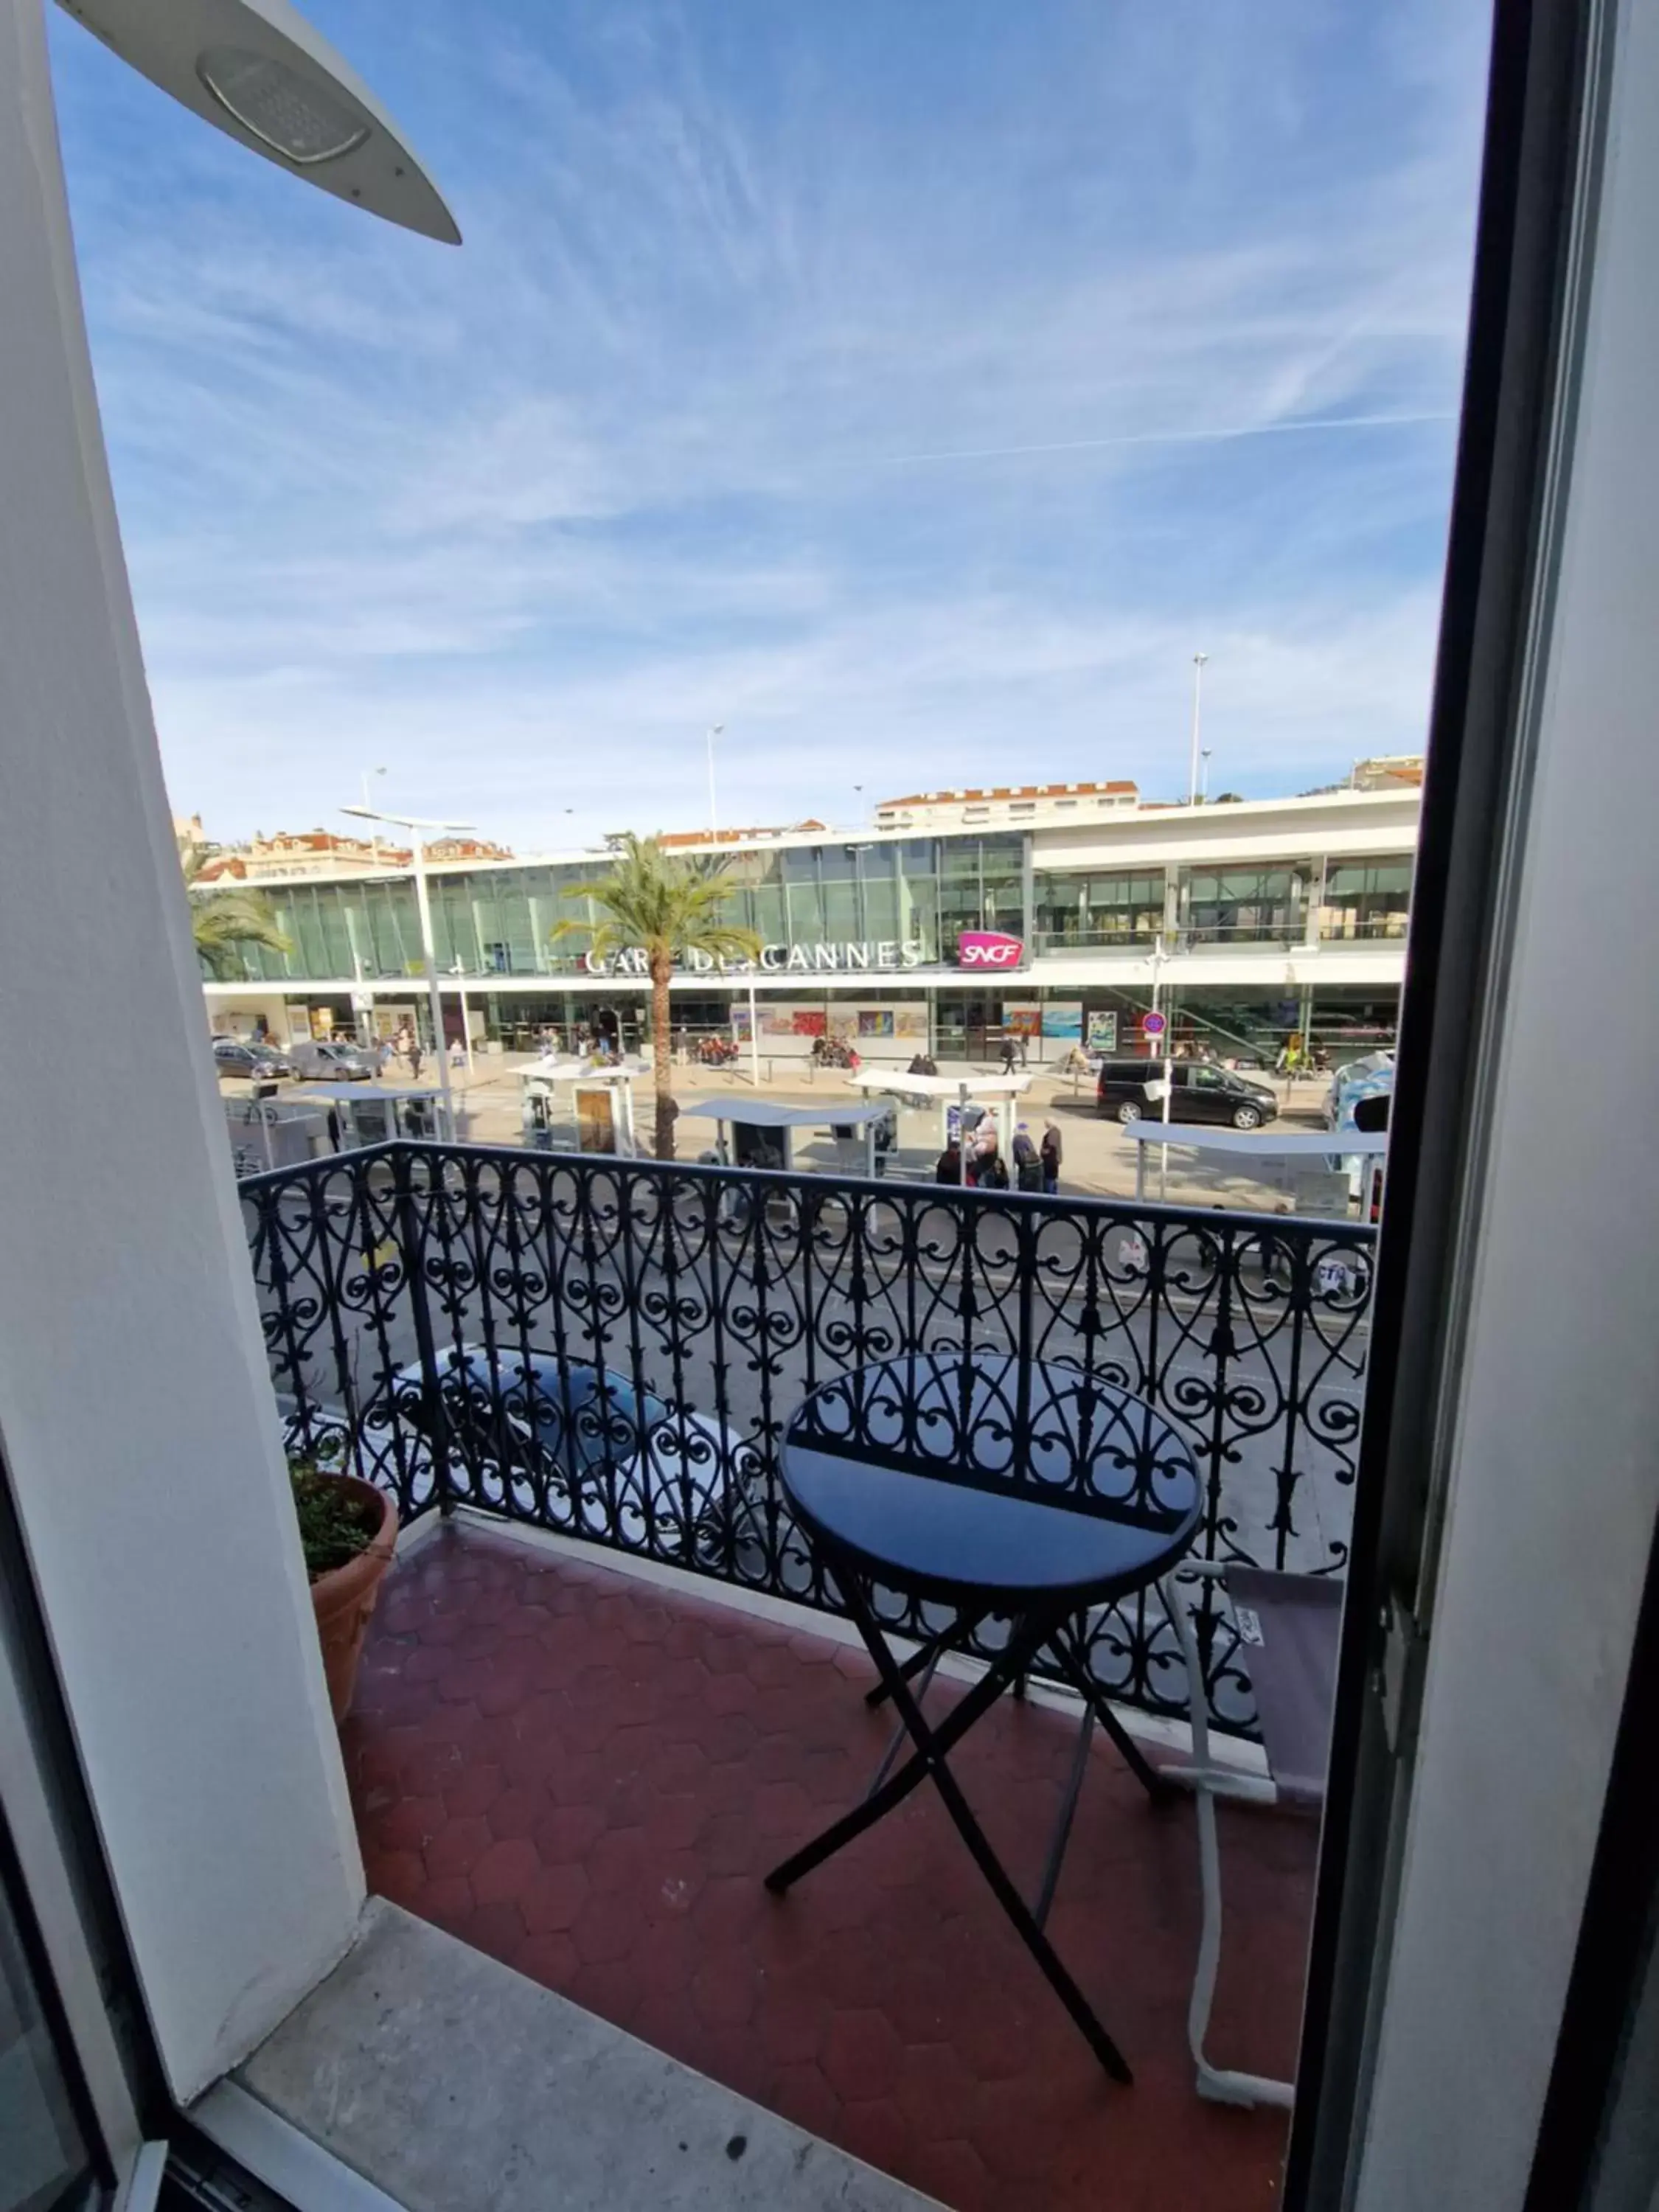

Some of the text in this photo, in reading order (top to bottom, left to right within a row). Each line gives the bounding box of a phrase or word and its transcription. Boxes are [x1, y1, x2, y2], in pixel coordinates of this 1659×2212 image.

[585, 947, 650, 973] GAR
[759, 940, 919, 970] CANNES
[961, 945, 1019, 963] SNCF
